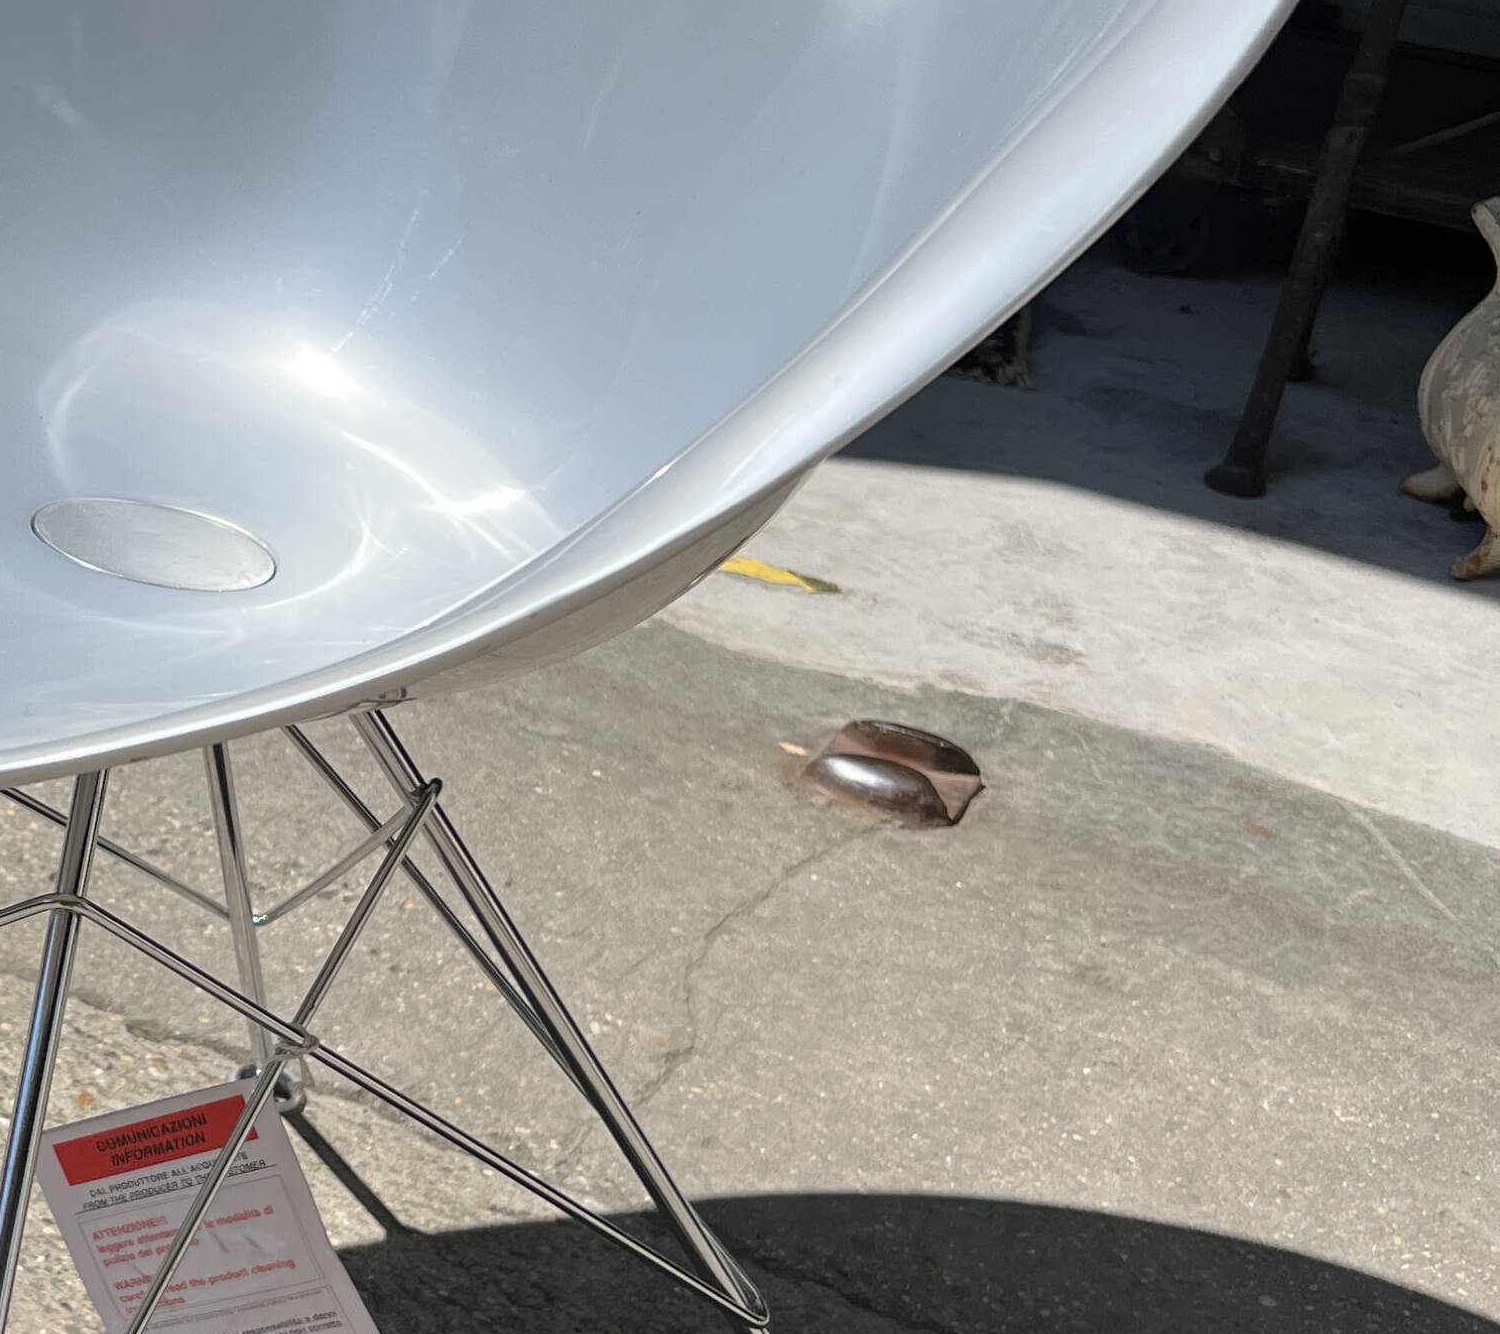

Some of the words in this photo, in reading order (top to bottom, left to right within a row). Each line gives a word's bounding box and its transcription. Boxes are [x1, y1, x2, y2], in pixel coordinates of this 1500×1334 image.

[96, 1115, 207, 1151] COMUNICAZIONI
[111, 1133, 206, 1165] INFORMATION
[109, 1172, 168, 1191] PRODUTTORE
[84, 1200, 106, 1210] FROM
[111, 1194, 127, 1204] THE
[130, 1182, 177, 1198] PRODUCER
[262, 1204, 275, 1215] di
[209, 1269, 248, 1284] product
